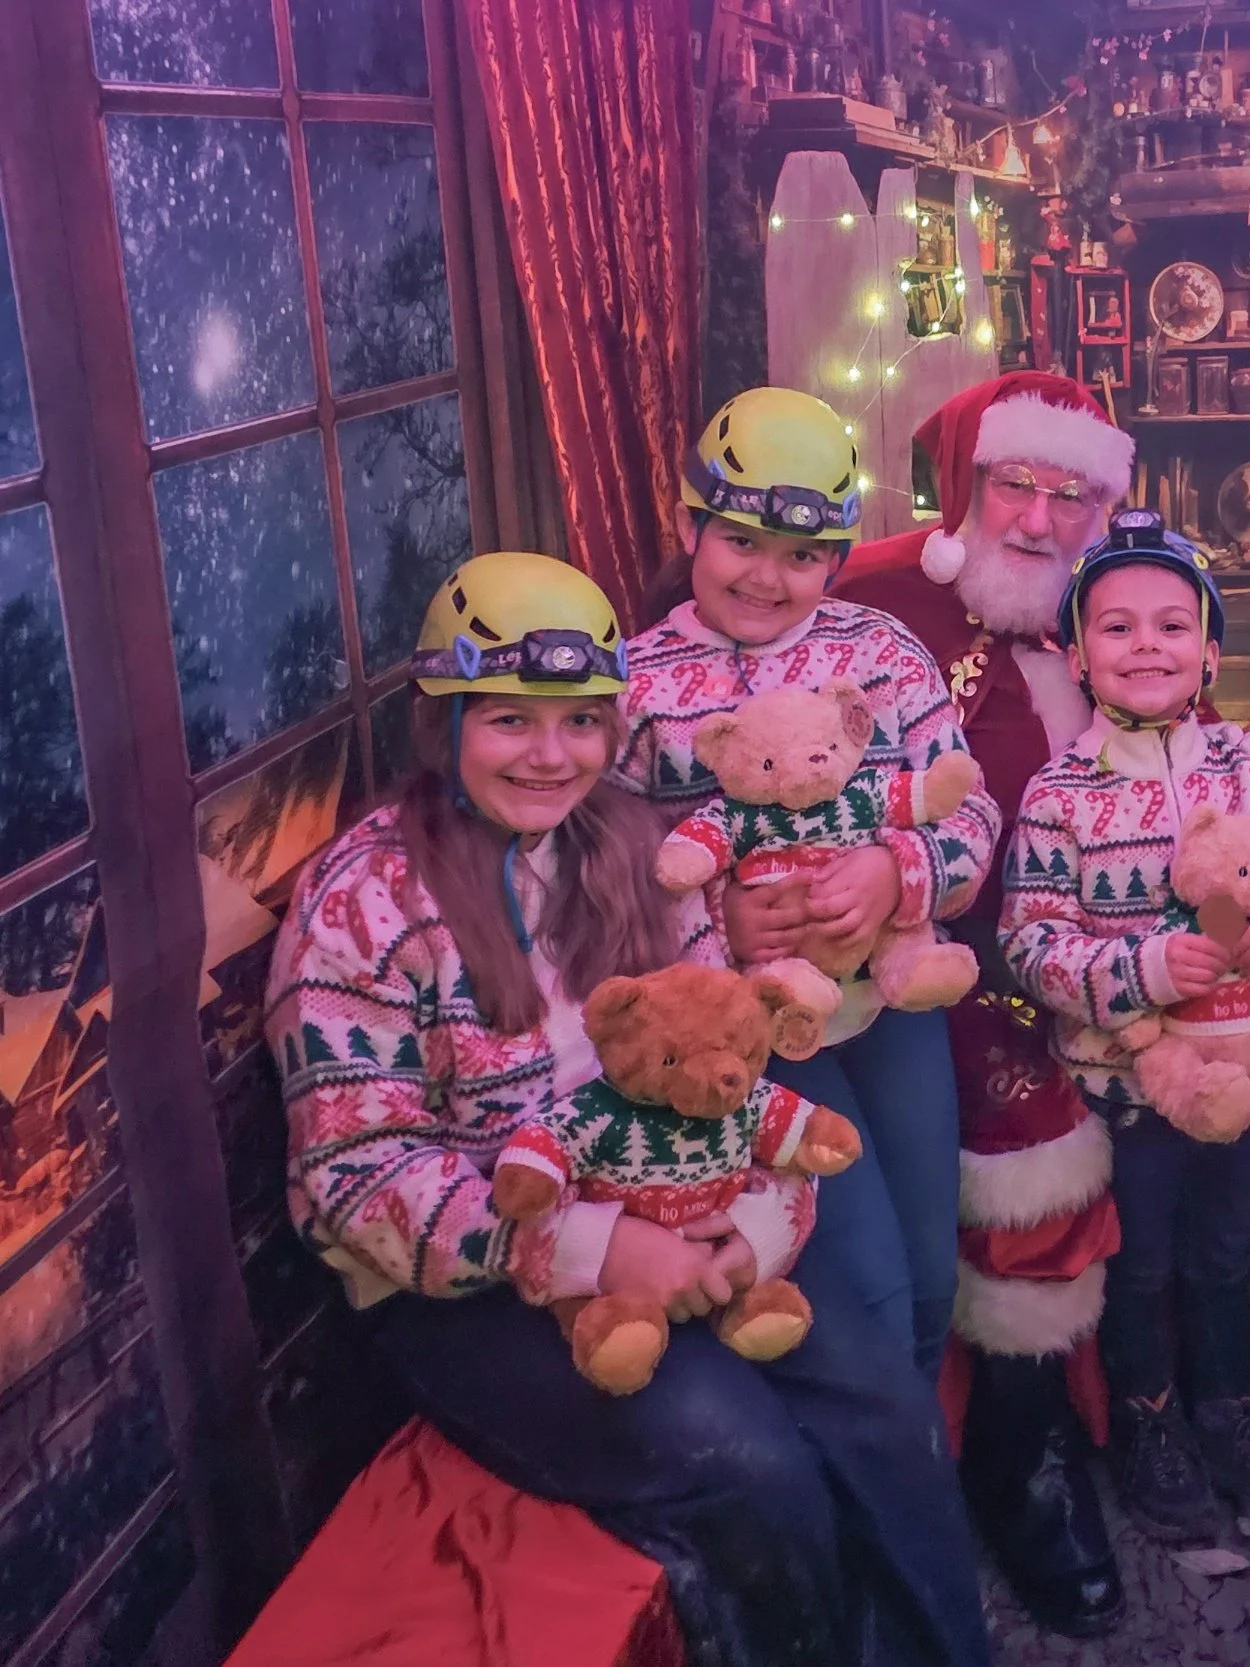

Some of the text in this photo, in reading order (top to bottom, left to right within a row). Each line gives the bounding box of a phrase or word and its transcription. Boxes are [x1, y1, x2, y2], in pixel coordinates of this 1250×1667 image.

[1213, 1002, 1230, 1018] ho
[1233, 1000, 1249, 1015] ho
[660, 1203, 679, 1222] ho
